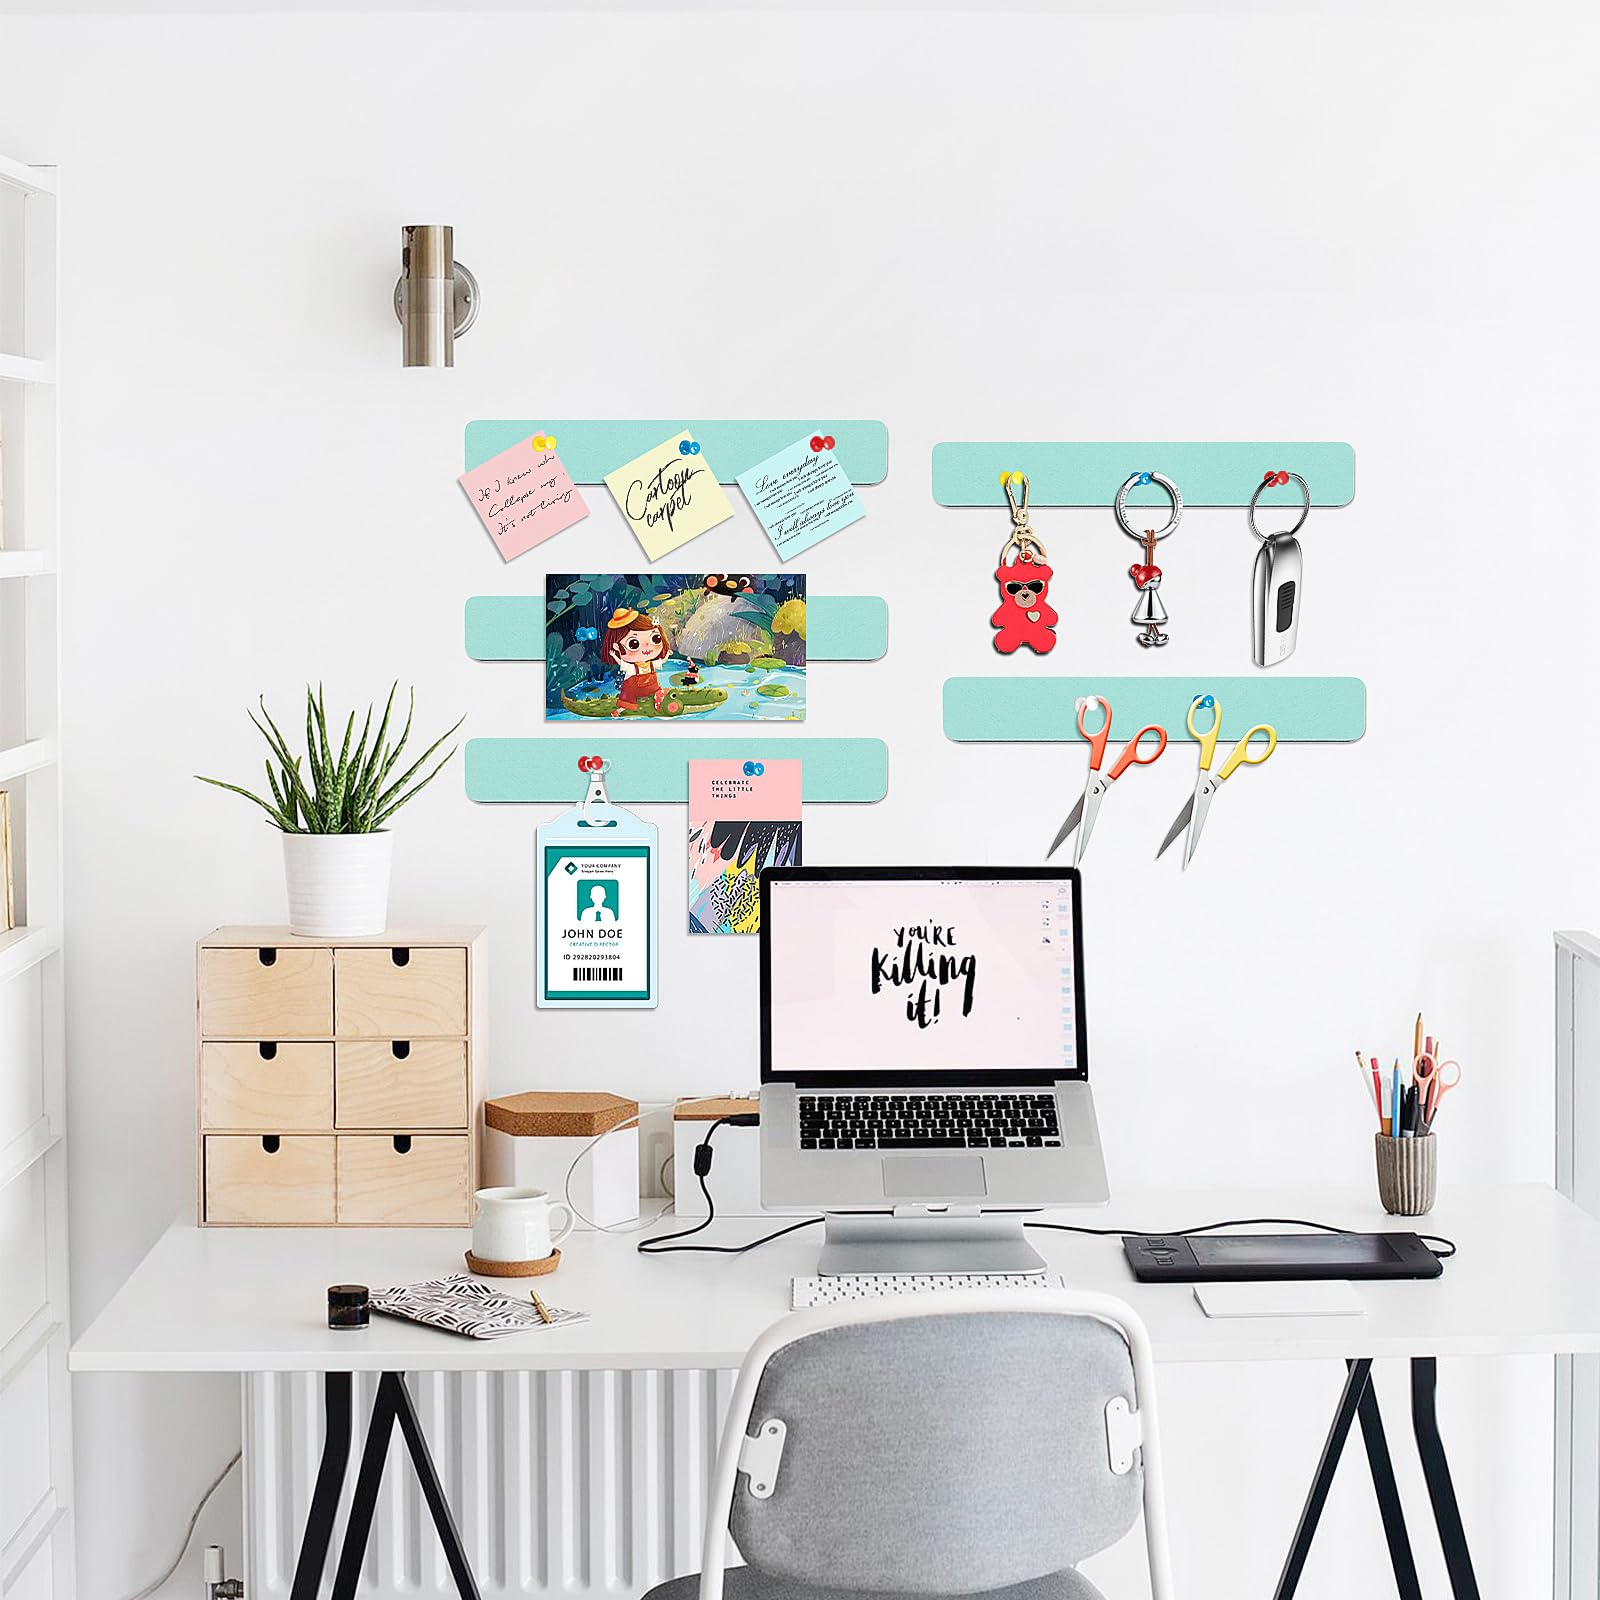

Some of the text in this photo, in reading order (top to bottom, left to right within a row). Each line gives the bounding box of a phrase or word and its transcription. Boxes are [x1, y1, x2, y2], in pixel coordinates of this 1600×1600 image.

[626, 459, 693, 520] Cartoon
[647, 470, 704, 532] carpet
[562, 929, 623, 938] JOHN DOE
[907, 980, 940, 1028] it!
